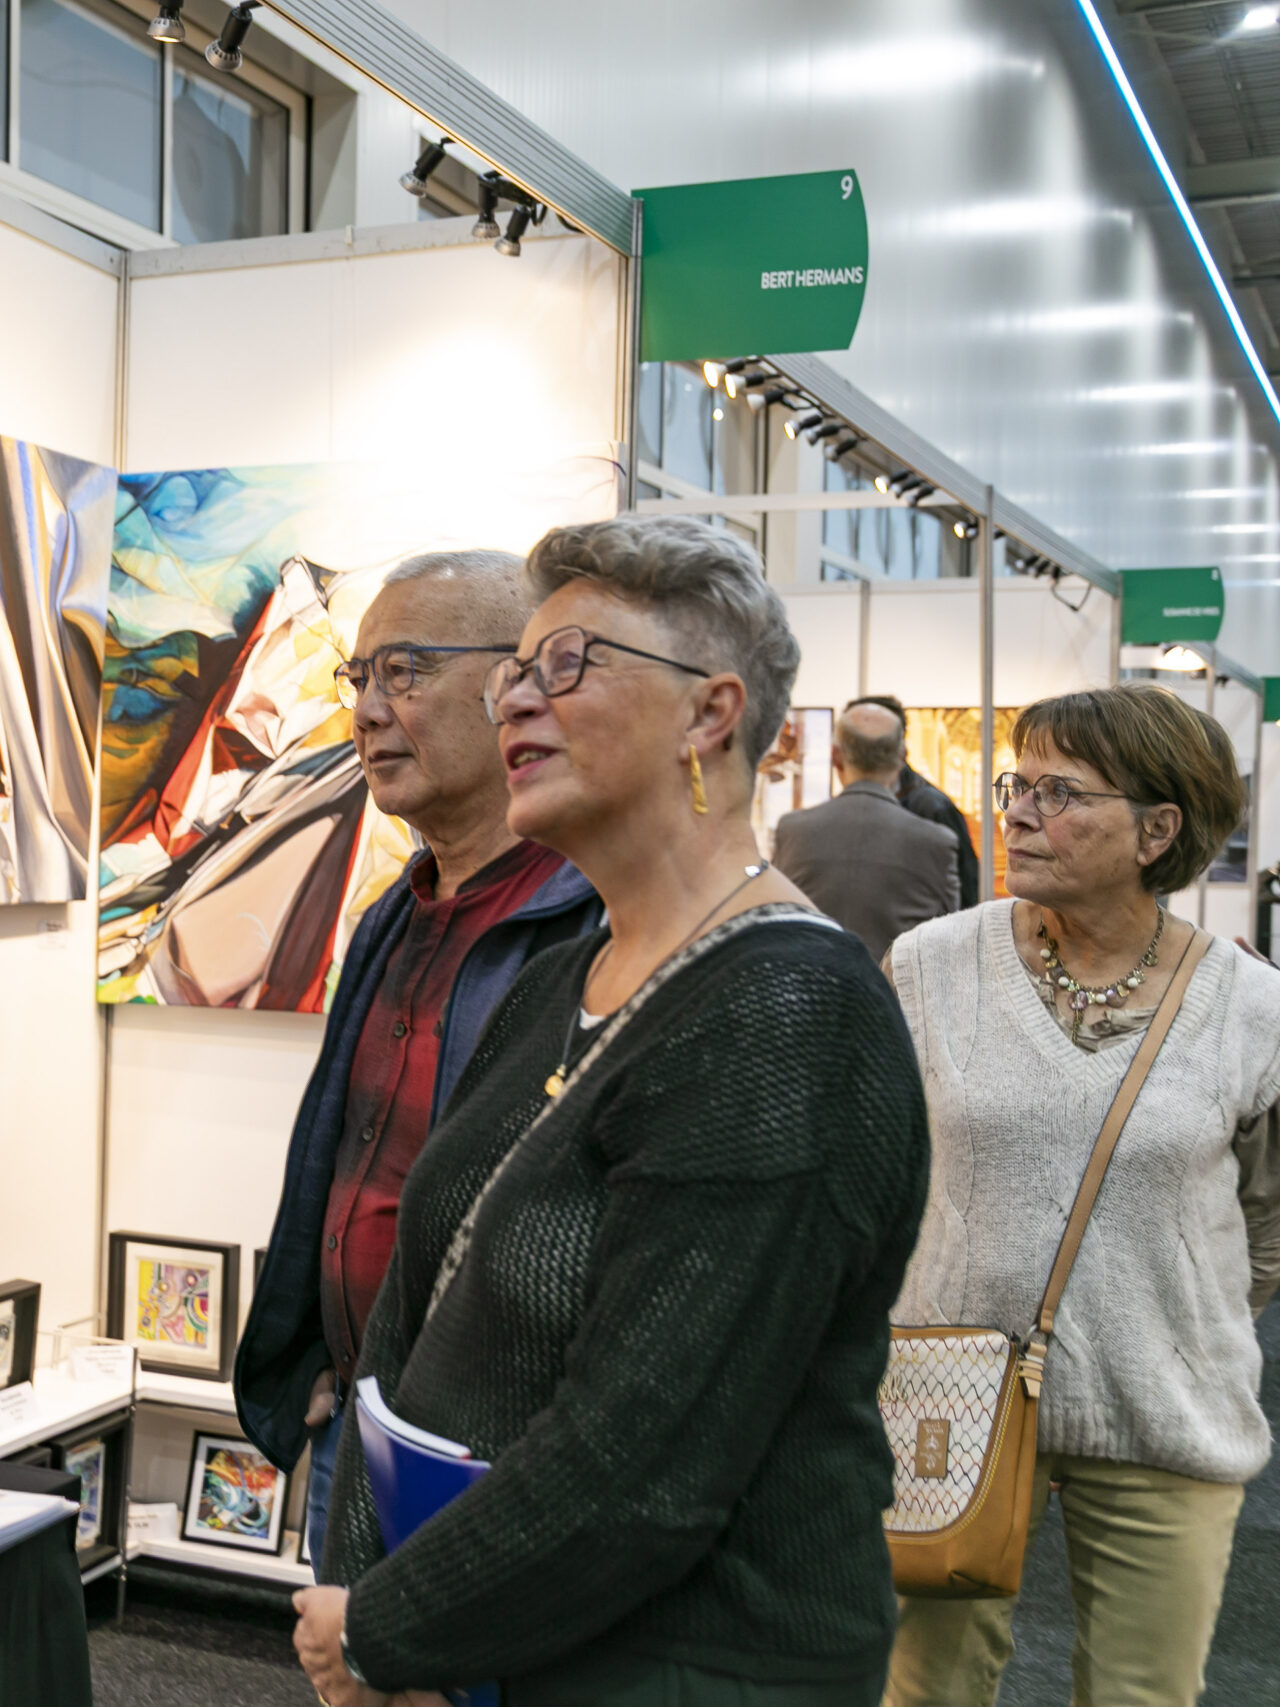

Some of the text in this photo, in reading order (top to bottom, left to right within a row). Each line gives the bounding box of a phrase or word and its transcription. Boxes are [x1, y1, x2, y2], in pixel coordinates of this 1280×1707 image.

[840, 175, 854, 200] 9
[761, 266, 864, 290] BERT HERMANS
